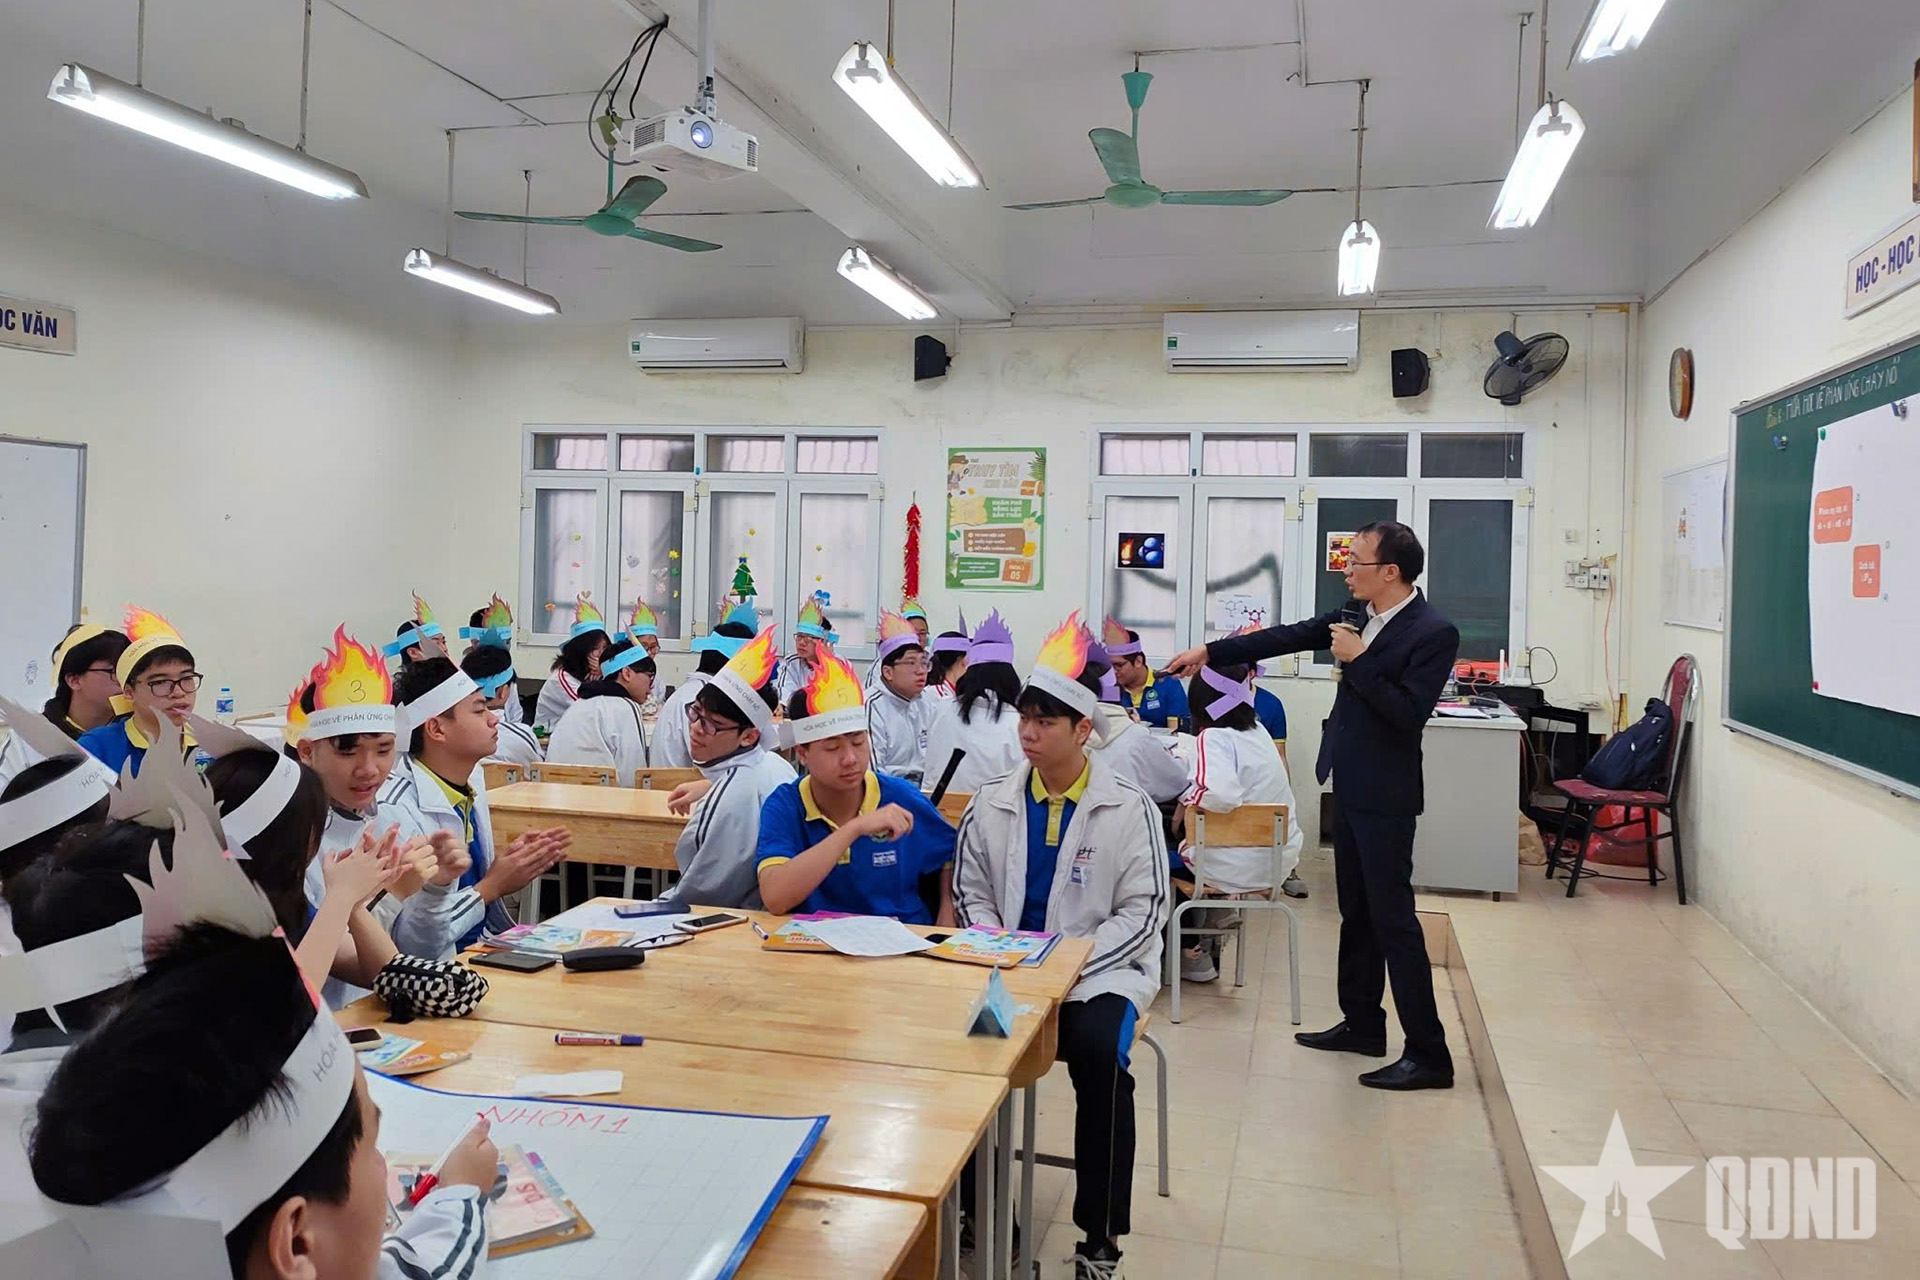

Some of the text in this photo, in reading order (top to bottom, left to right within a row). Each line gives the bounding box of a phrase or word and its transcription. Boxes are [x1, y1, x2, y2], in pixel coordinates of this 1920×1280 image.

[1855, 256, 1879, 293] HỌC
[1887, 235, 1915, 275] HỌC
[22, 310, 57, 338] VĂN
[347, 679, 366, 703] 3
[837, 687, 848, 705] 5
[342, 711, 365, 722] PHẢN
[366, 711, 383, 721] ỨNG
[484, 1105, 630, 1134] NHÓM 1
